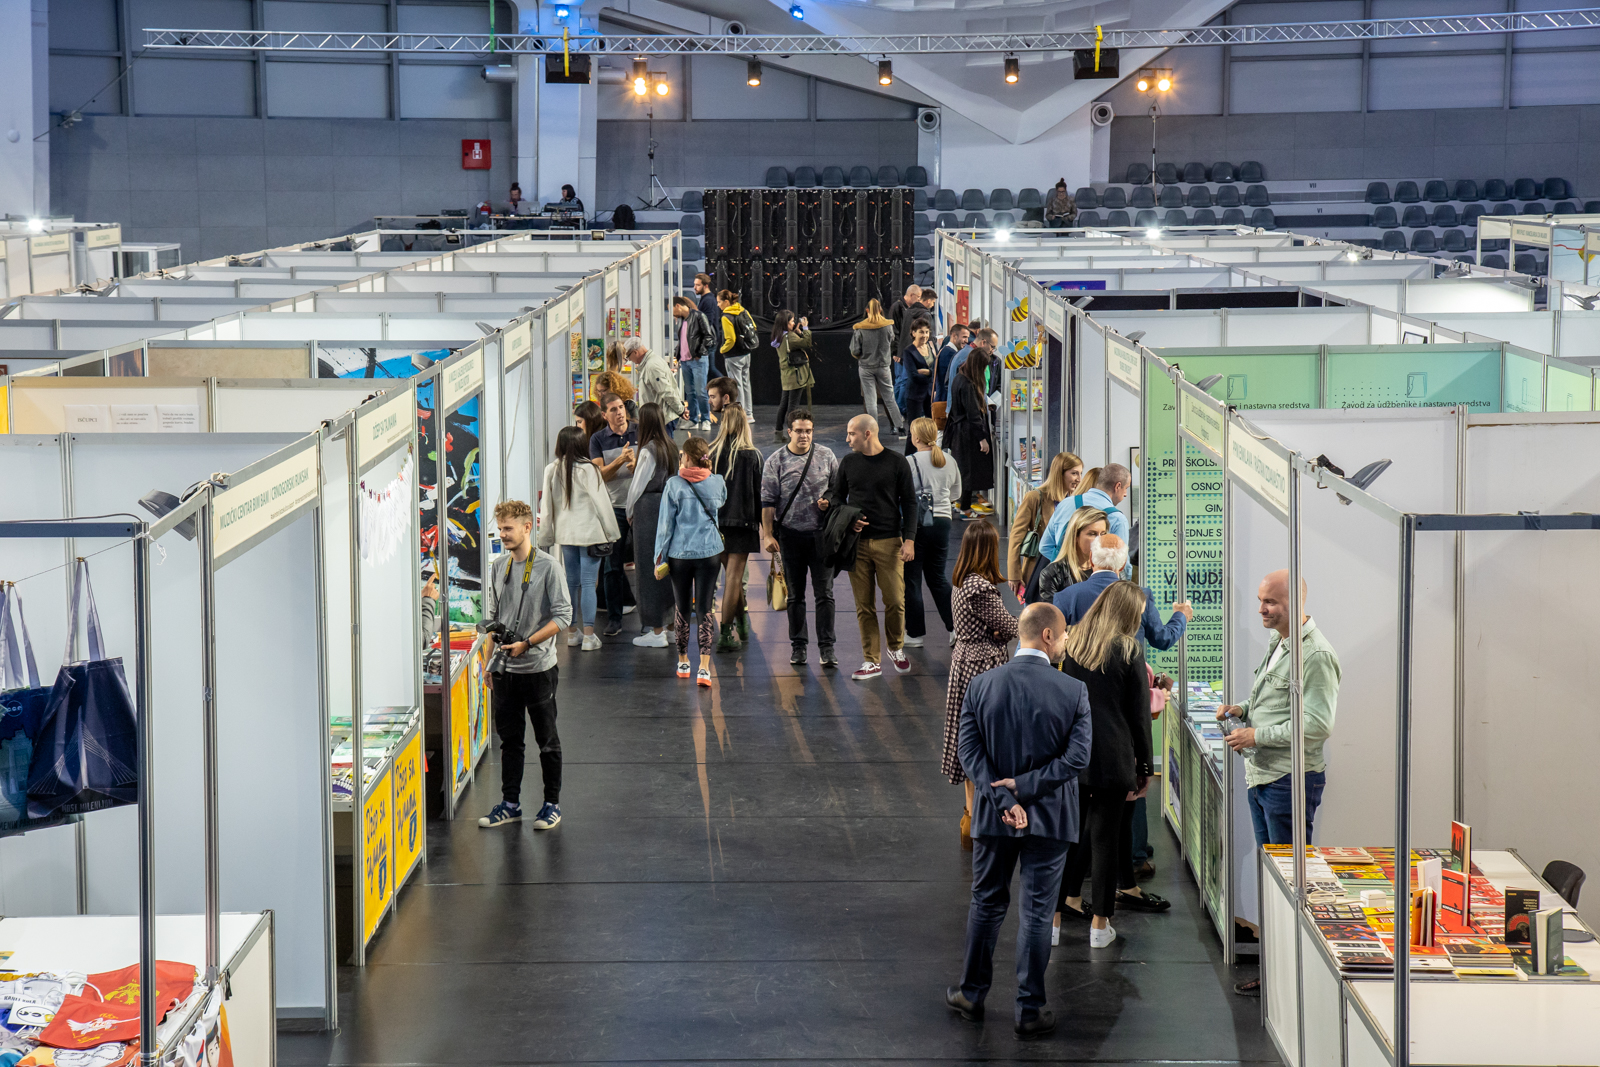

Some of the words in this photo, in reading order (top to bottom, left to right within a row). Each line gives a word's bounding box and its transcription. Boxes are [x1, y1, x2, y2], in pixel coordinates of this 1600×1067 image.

[220, 506, 237, 530] MUZIČKI
[238, 501, 252, 520] CENTAR
[260, 490, 269, 507] BAM
[272, 478, 294, 500] CRNOGORSKI
[295, 468, 309, 486] RUKSAK
